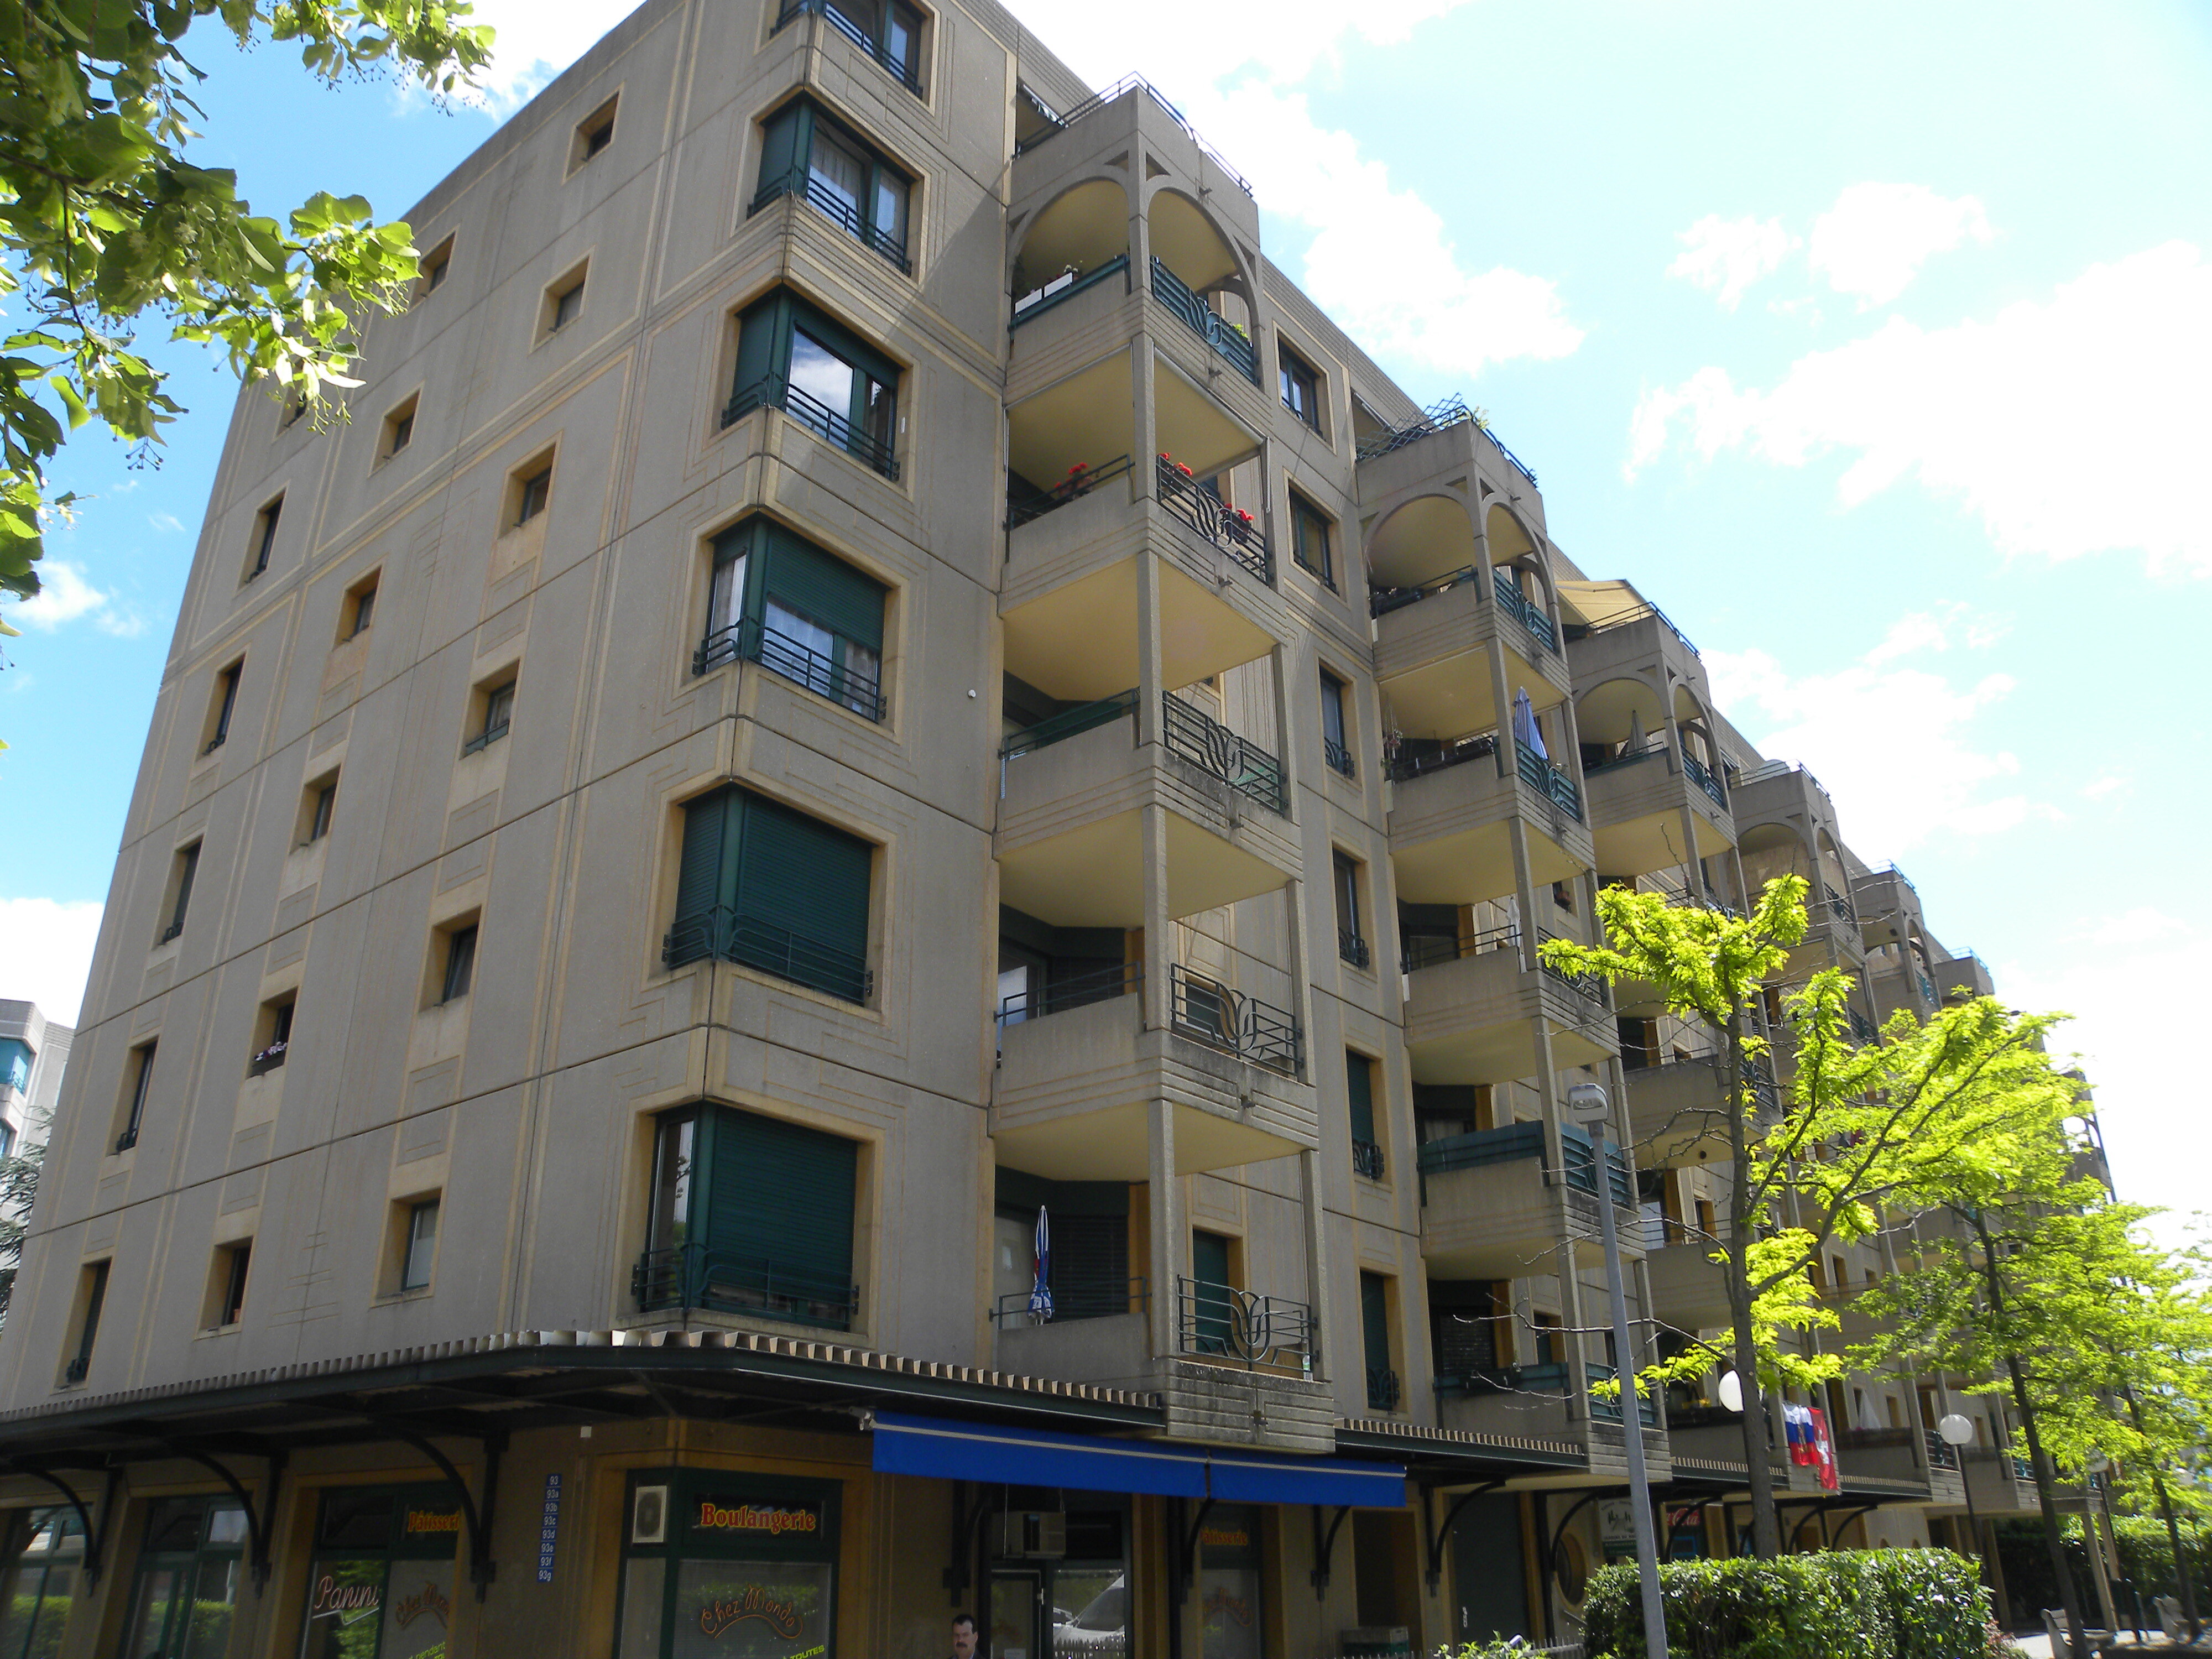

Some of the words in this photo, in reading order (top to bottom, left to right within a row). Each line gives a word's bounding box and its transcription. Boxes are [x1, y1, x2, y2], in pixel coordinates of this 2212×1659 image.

[550, 1475, 559, 1485] 93
[547, 1489, 559, 1499] 93a
[545, 1503, 557, 1512] 93b
[407, 1510, 460, 1532] Pâtisseri
[544, 1516, 556, 1525] 93c
[701, 1503, 816, 1535] Boulangerie
[542, 1529, 555, 1539] 93d
[541, 1543, 554, 1552] 93e
[540, 1556, 552, 1567] 93f
[539, 1569, 552, 1582] 93g
[314, 1575, 379, 1609] Panini
[701, 1600, 741, 1634] Chez
[744, 1584, 795, 1627] Mondo
